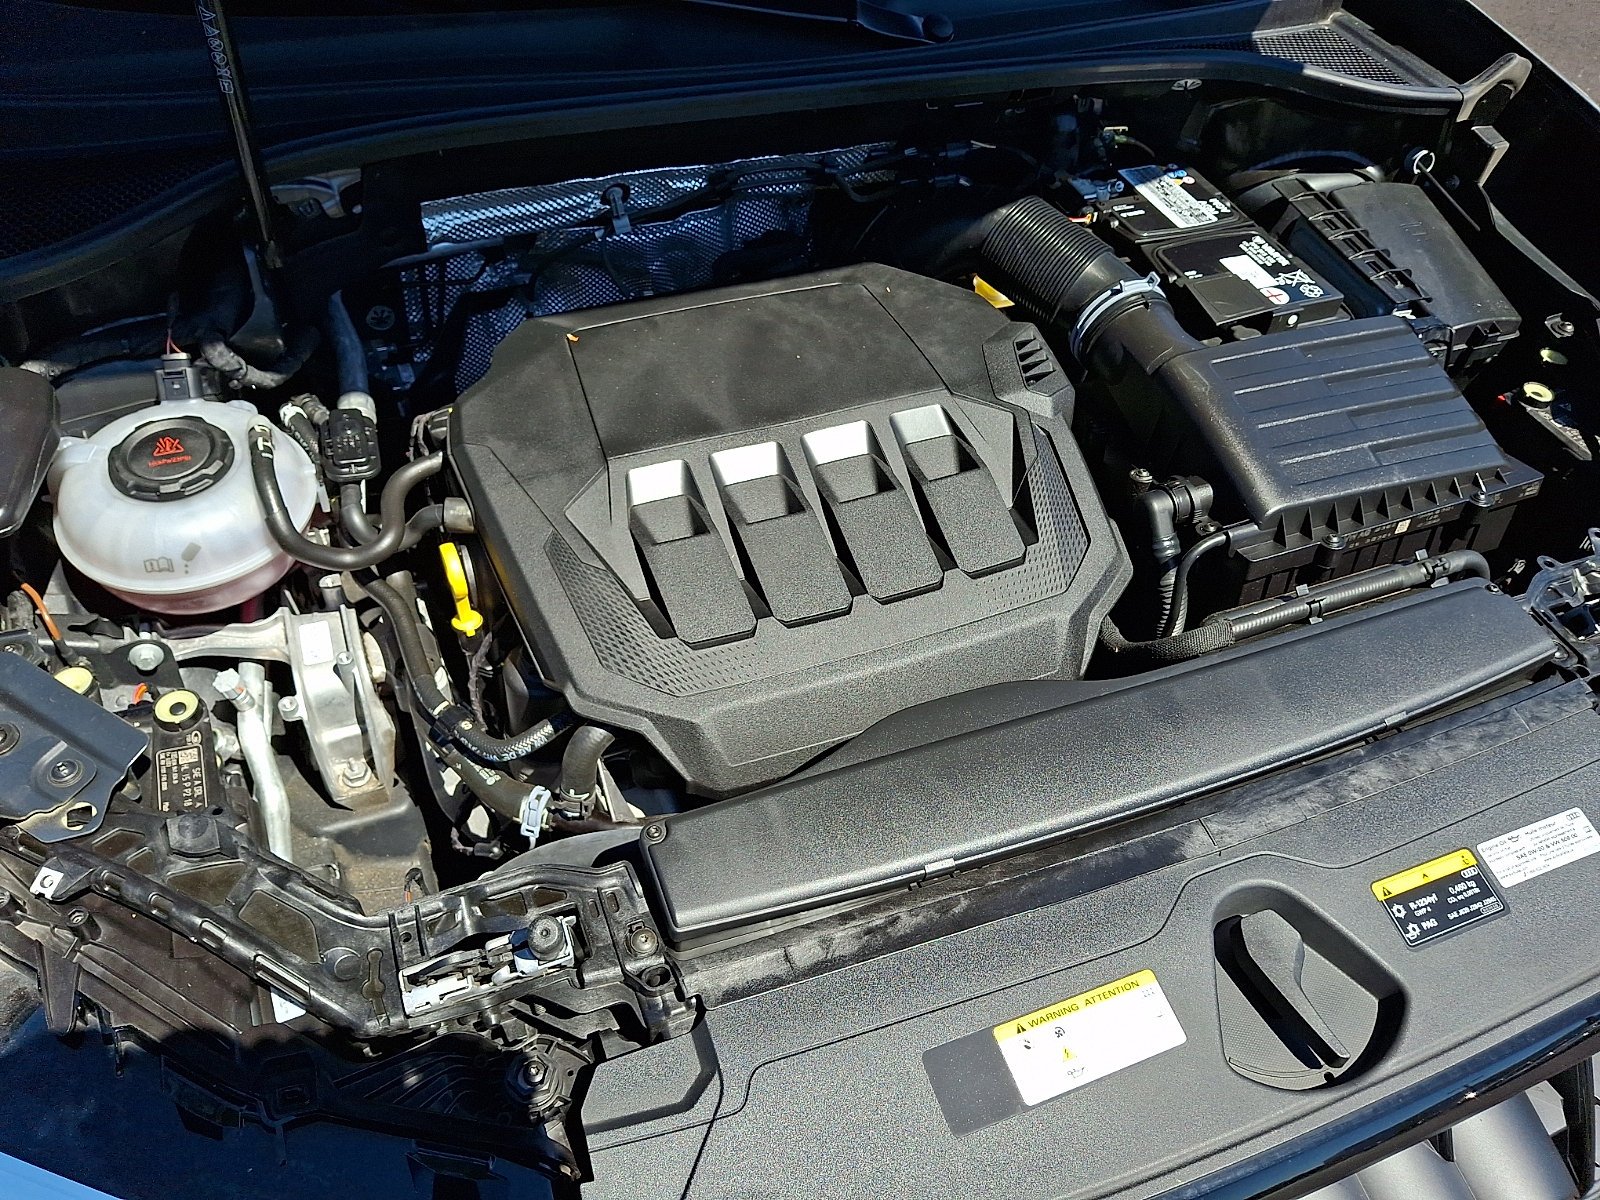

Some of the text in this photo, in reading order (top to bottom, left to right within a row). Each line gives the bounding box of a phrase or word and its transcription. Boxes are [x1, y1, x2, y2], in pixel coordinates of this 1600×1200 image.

[1481, 843, 1499, 853] Engine
[1516, 853, 1528, 861] SAE
[1027, 979, 1140, 1028] WARNING ATTENTION
